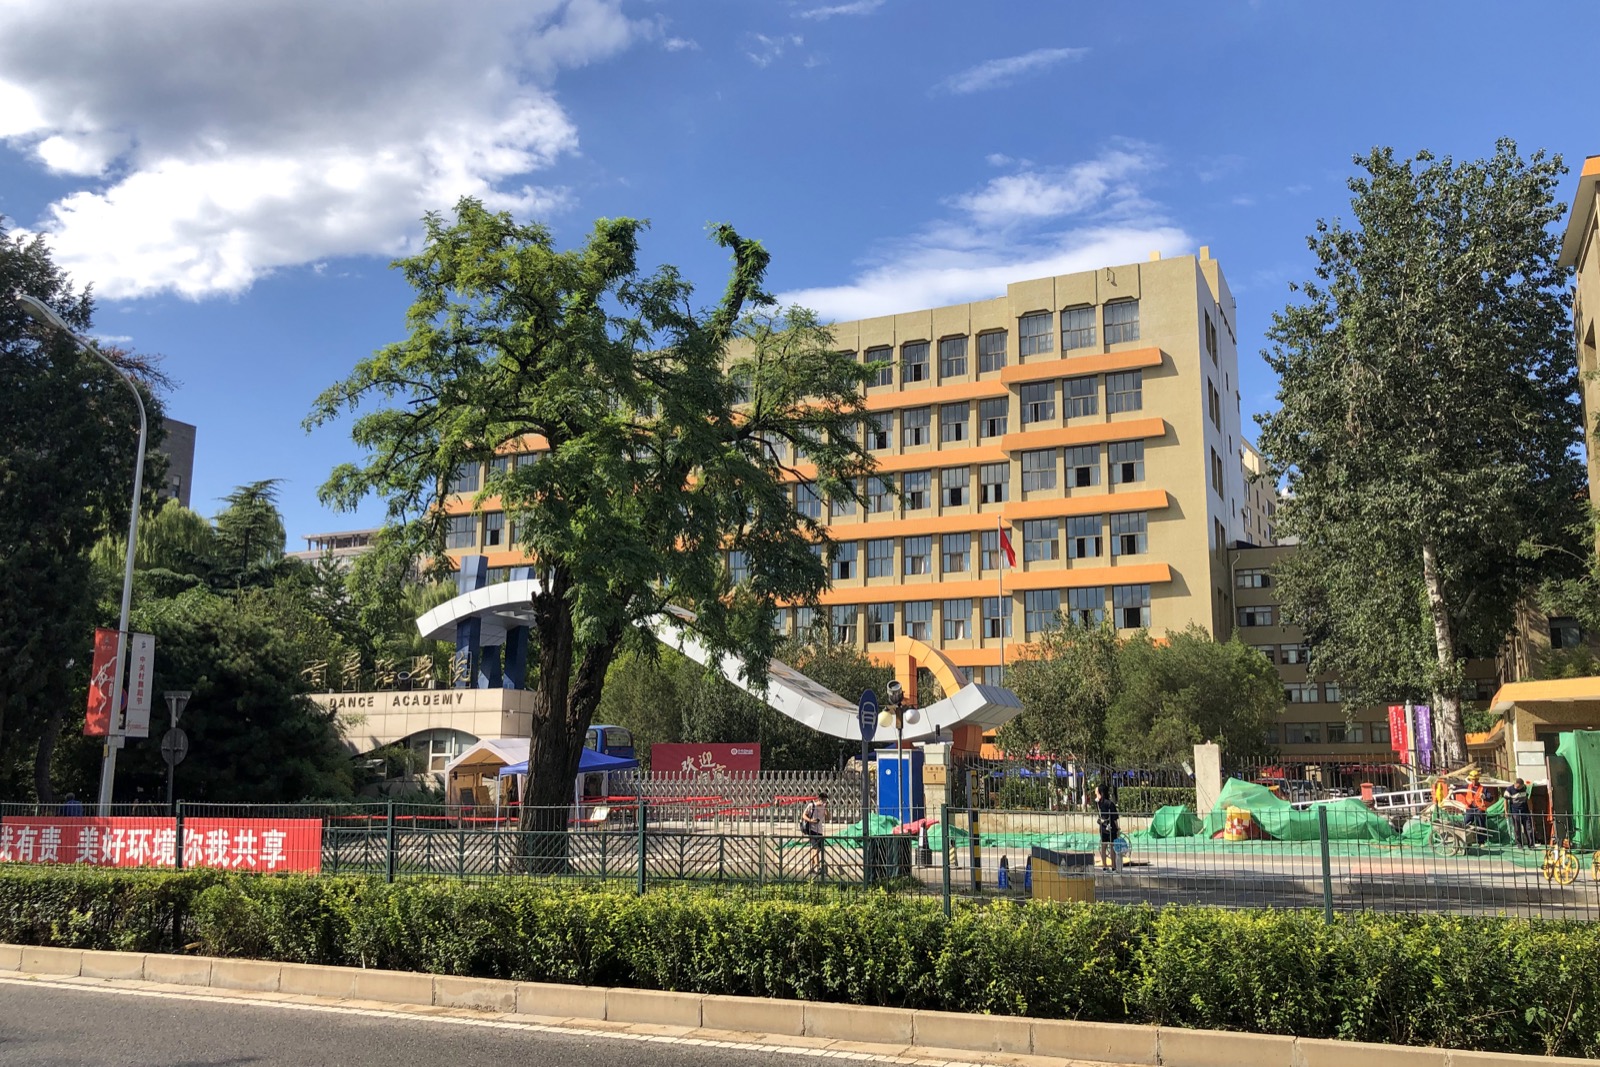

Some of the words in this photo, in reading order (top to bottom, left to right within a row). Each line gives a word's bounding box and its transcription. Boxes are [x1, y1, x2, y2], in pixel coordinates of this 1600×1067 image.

[329, 696, 374, 708] DANCE
[392, 693, 464, 707] ACADEMY
[681, 751, 716, 773] 欢迎
[76, 826, 287, 869] 美好环境你我共享
